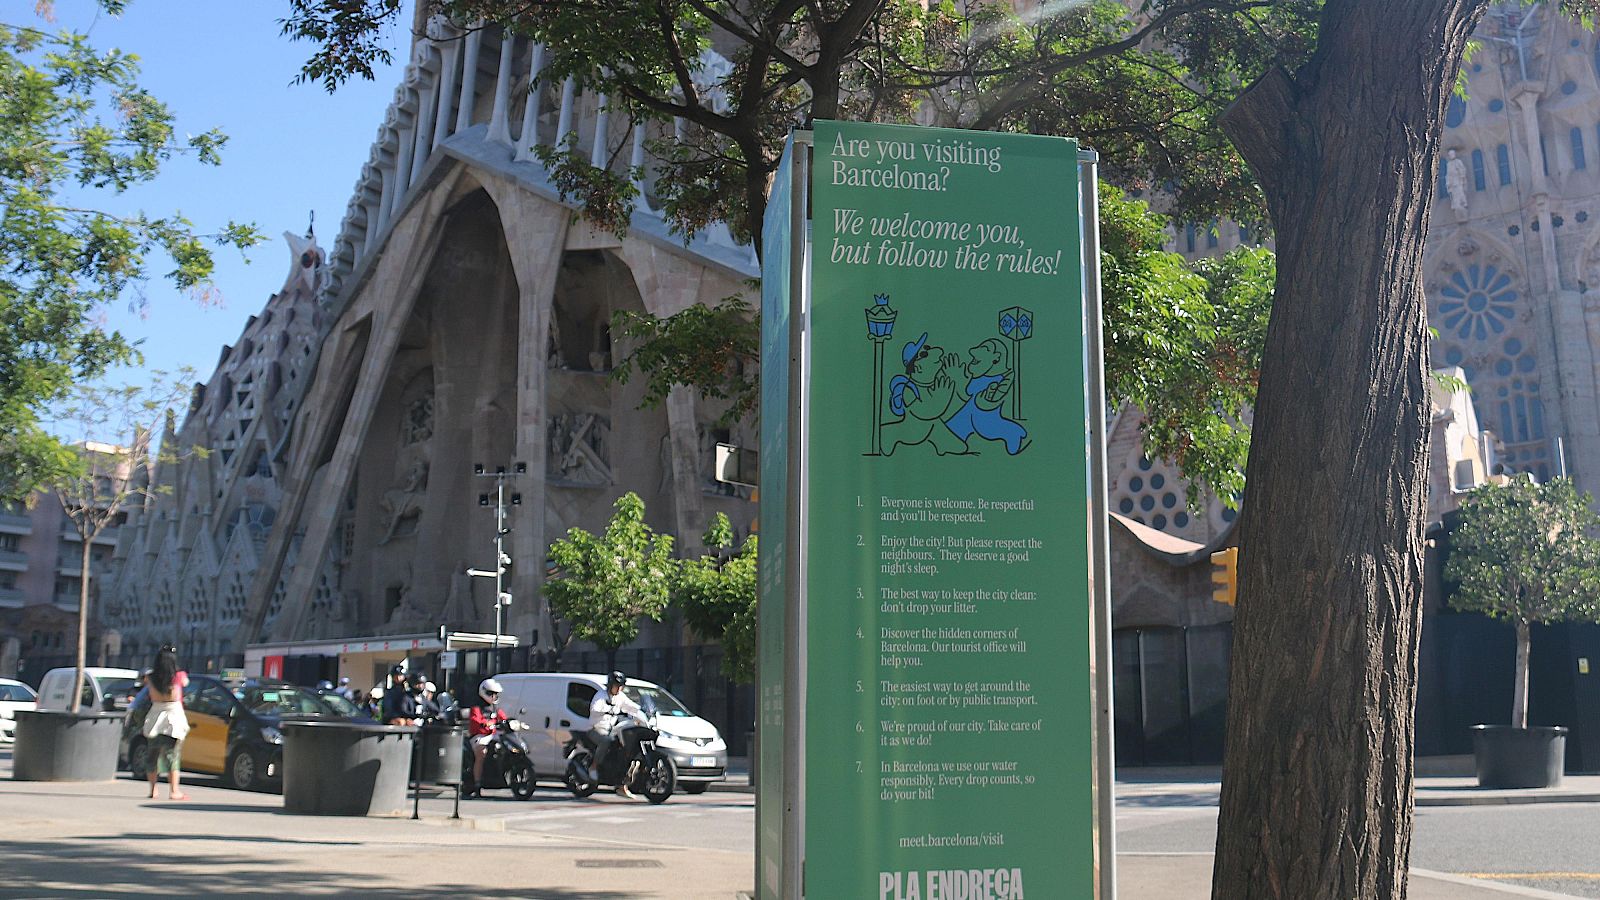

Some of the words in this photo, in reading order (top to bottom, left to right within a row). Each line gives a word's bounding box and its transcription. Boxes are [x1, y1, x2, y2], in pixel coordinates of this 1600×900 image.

[831, 132, 870, 157] Are
[876, 141, 915, 164] you
[922, 139, 1002, 172] visiting
[831, 161, 950, 191] Barcelona?
[833, 209, 863, 235] We
[870, 213, 971, 241] welcome
[976, 224, 1024, 249] you,
[831, 238, 871, 265] but
[877, 240, 947, 269] follow
[955, 245, 990, 271] the
[996, 250, 1061, 275] rules!
[857, 496, 863, 507] 1.
[881, 496, 923, 510] Everyone
[925, 497, 932, 508] is
[934, 497, 975, 509] welcome.
[978, 498, 989, 509] Be
[991, 499, 1034, 512] respectful
[881, 510, 899, 521] and
[929, 511, 940, 522] be
[941, 512, 985, 524] respected.
[857, 535, 865, 546] 2.
[881, 536, 907, 550] Enjoy
[910, 536, 924, 547] the
[926, 536, 945, 550] city!
[948, 537, 963, 548] But
[965, 537, 992, 550] please
[995, 539, 1026, 551] respect
[1028, 538, 1042, 548] the
[881, 549, 935, 563] neighbours.
[940, 549, 963, 563] They
[965, 550, 997, 561] deserve
[1000, 553, 1004, 561] a
[1007, 551, 1029, 563] good
[914, 563, 938, 576] sleep.
[857, 588, 864, 599] 3.
[881, 588, 898, 599] The
[901, 588, 919, 599] best
[921, 591, 939, 601] way
[942, 590, 950, 600] to
[953, 589, 973, 602] keep
[976, 589, 991, 600] the
[992, 589, 1008, 602] city
[907, 602, 929, 615] drop
[931, 605, 951, 615] your
[954, 602, 977, 613] litter.
[856, 627, 865, 639] 4.
[881, 628, 919, 639] Discover
[922, 628, 937, 639] the
[939, 628, 970, 639] hidden
[973, 630, 1006, 639] corners
[1009, 628, 1018, 639] of
[881, 642, 929, 652] Barcelona.
[932, 642, 949, 652] Our
[952, 642, 981, 652] tourist
[983, 642, 1007, 652] office
[1009, 642, 1026, 652] will
[881, 655, 901, 668] help
[903, 658, 923, 668] you.
[856, 681, 864, 692] 5.
[881, 681, 899, 692] The
[901, 682, 930, 692] easiest
[933, 683, 950, 694] way
[953, 681, 962, 691] to
[965, 682, 979, 694] get
[980, 681, 1013, 691] around
[1016, 681, 1030, 691] the
[902, 696, 914, 705] on
[917, 694, 935, 705] foot
[937, 696, 947, 705] or
[950, 694, 960, 708] by
[963, 694, 991, 707] public
[993, 695, 1037, 707] transport.
[856, 721, 864, 732] 6.
[907, 720, 935, 734] proud
[938, 720, 947, 732] of
[950, 722, 964, 731] our
[967, 720, 986, 733] city.
[988, 720, 1008, 731] Take
[1010, 721, 1030, 731] care
[1032, 720, 1042, 730] of
[881, 735, 887, 745] it
[890, 736, 899, 745] as
[902, 736, 914, 745] we
[917, 735, 932, 745] do!
[856, 761, 863, 773] 7.
[881, 761, 890, 772] In
[893, 761, 939, 772] Barcelona
[942, 762, 954, 771] we
[957, 762, 971, 771] use
[974, 762, 989, 771] our
[992, 761, 1018, 771] water
[881, 775, 936, 788] responsibly.
[939, 775, 964, 787] Every
[966, 774, 988, 787] drop
[990, 774, 1023, 785] counts,
[1025, 775, 1035, 784] so
[880, 789, 893, 800] do
[895, 790, 917, 803] your
[919, 788, 934, 800] bit!
[900, 832, 1004, 848] meet.barcelona/visit
[880, 871, 921, 900] PLA
[926, 868, 1024, 900] ENDREÇA
